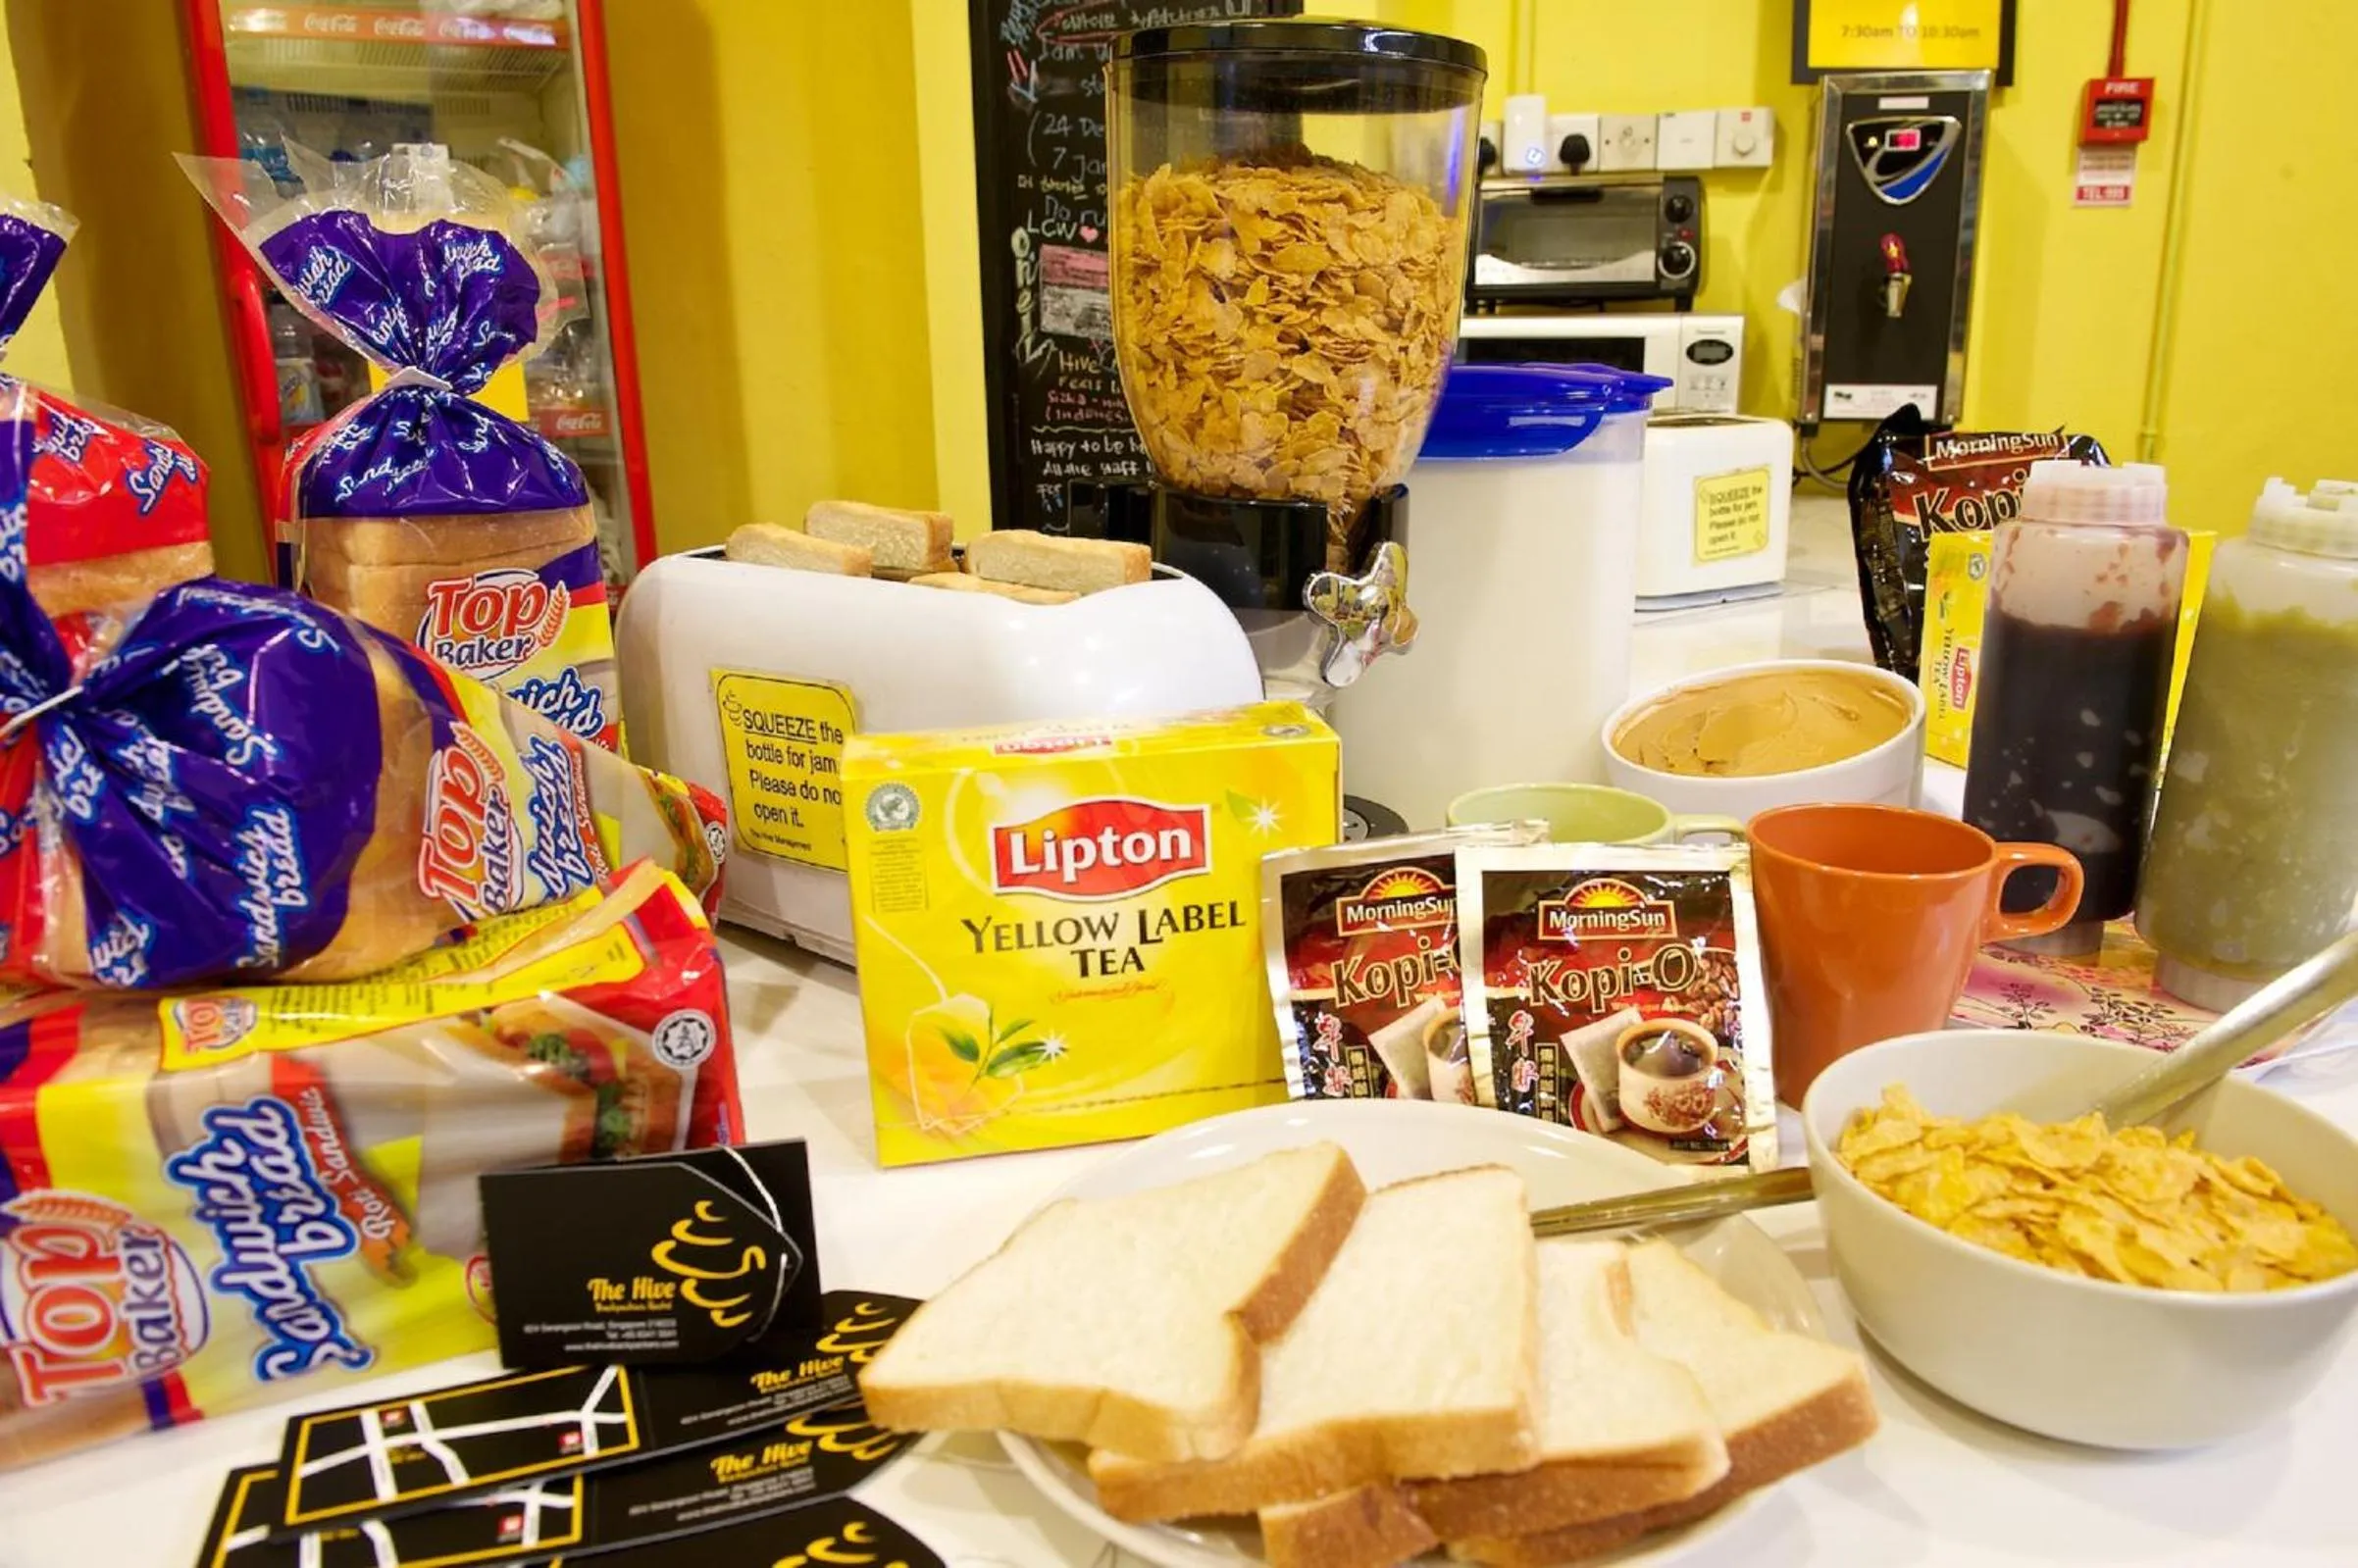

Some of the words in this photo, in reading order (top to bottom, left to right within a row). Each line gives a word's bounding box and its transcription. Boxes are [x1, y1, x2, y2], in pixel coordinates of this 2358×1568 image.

[1934, 432, 2059, 461] MorningSun
[427, 575, 549, 637] Top
[436, 631, 538, 666] Baker
[1953, 647, 1971, 708] Lipton
[743, 708, 817, 739] SQUEEZE
[819, 720, 844, 745] the
[745, 738, 784, 765] bottle
[786, 744, 805, 769] for
[748, 768, 797, 798] Please
[799, 782, 819, 801] do
[823, 788, 842, 806] no
[419, 745, 485, 902] Top
[753, 802, 789, 829] open
[479, 784, 510, 915] Baker
[1008, 825, 1194, 884] Lipton
[960, 912, 1120, 955] YELLOW
[1138, 900, 1247, 945] LABEL
[1549, 909, 1666, 932] MorningSun
[1070, 945, 1146, 979] TEA
[1330, 936, 1461, 1009] Kopi-
[1527, 942, 1698, 1015] Kopi-O
[214, 1103, 346, 1254] bread
[119, 1224, 182, 1375] Baker
[587, 1277, 626, 1301] The
[631, 1276, 677, 1300] Hive
[8, 1219, 128, 1409] Top
[749, 1369, 793, 1391] The
[799, 1355, 845, 1378] Hive
[710, 1453, 755, 1476] The
[761, 1440, 813, 1465] Hive
